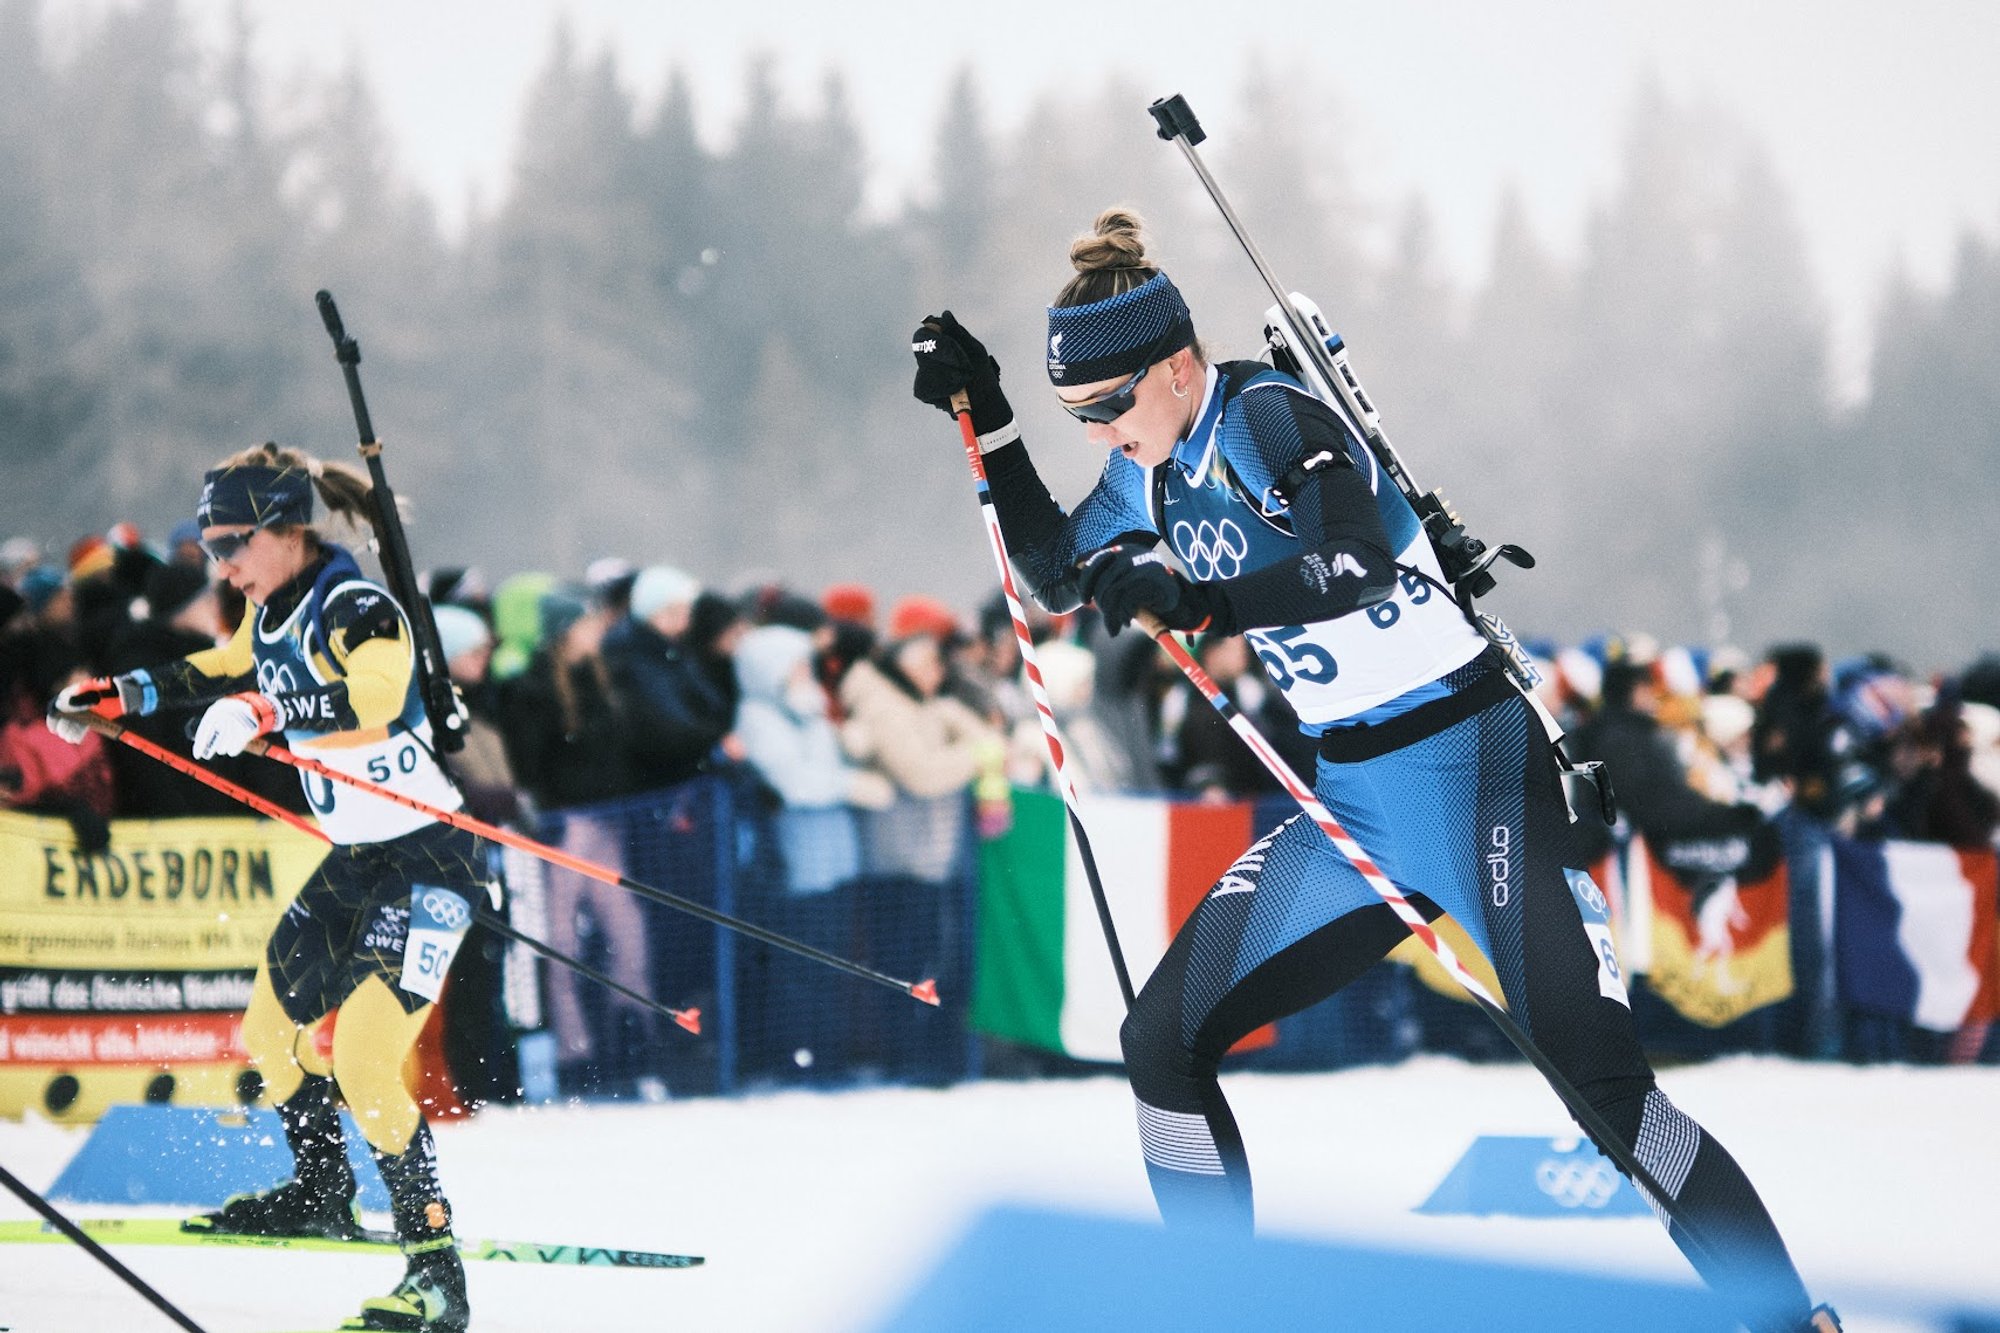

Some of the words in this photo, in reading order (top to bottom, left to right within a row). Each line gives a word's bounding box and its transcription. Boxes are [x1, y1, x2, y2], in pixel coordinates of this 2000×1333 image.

[1302, 554, 1329, 595] ESTONIA
[1311, 552, 1332, 578] TEAM
[1365, 563, 1432, 630] 65
[1245, 624, 1339, 692] 65
[367, 745, 417, 783] 50
[1487, 826, 1509, 907] odlo
[363, 932, 405, 954] SWE
